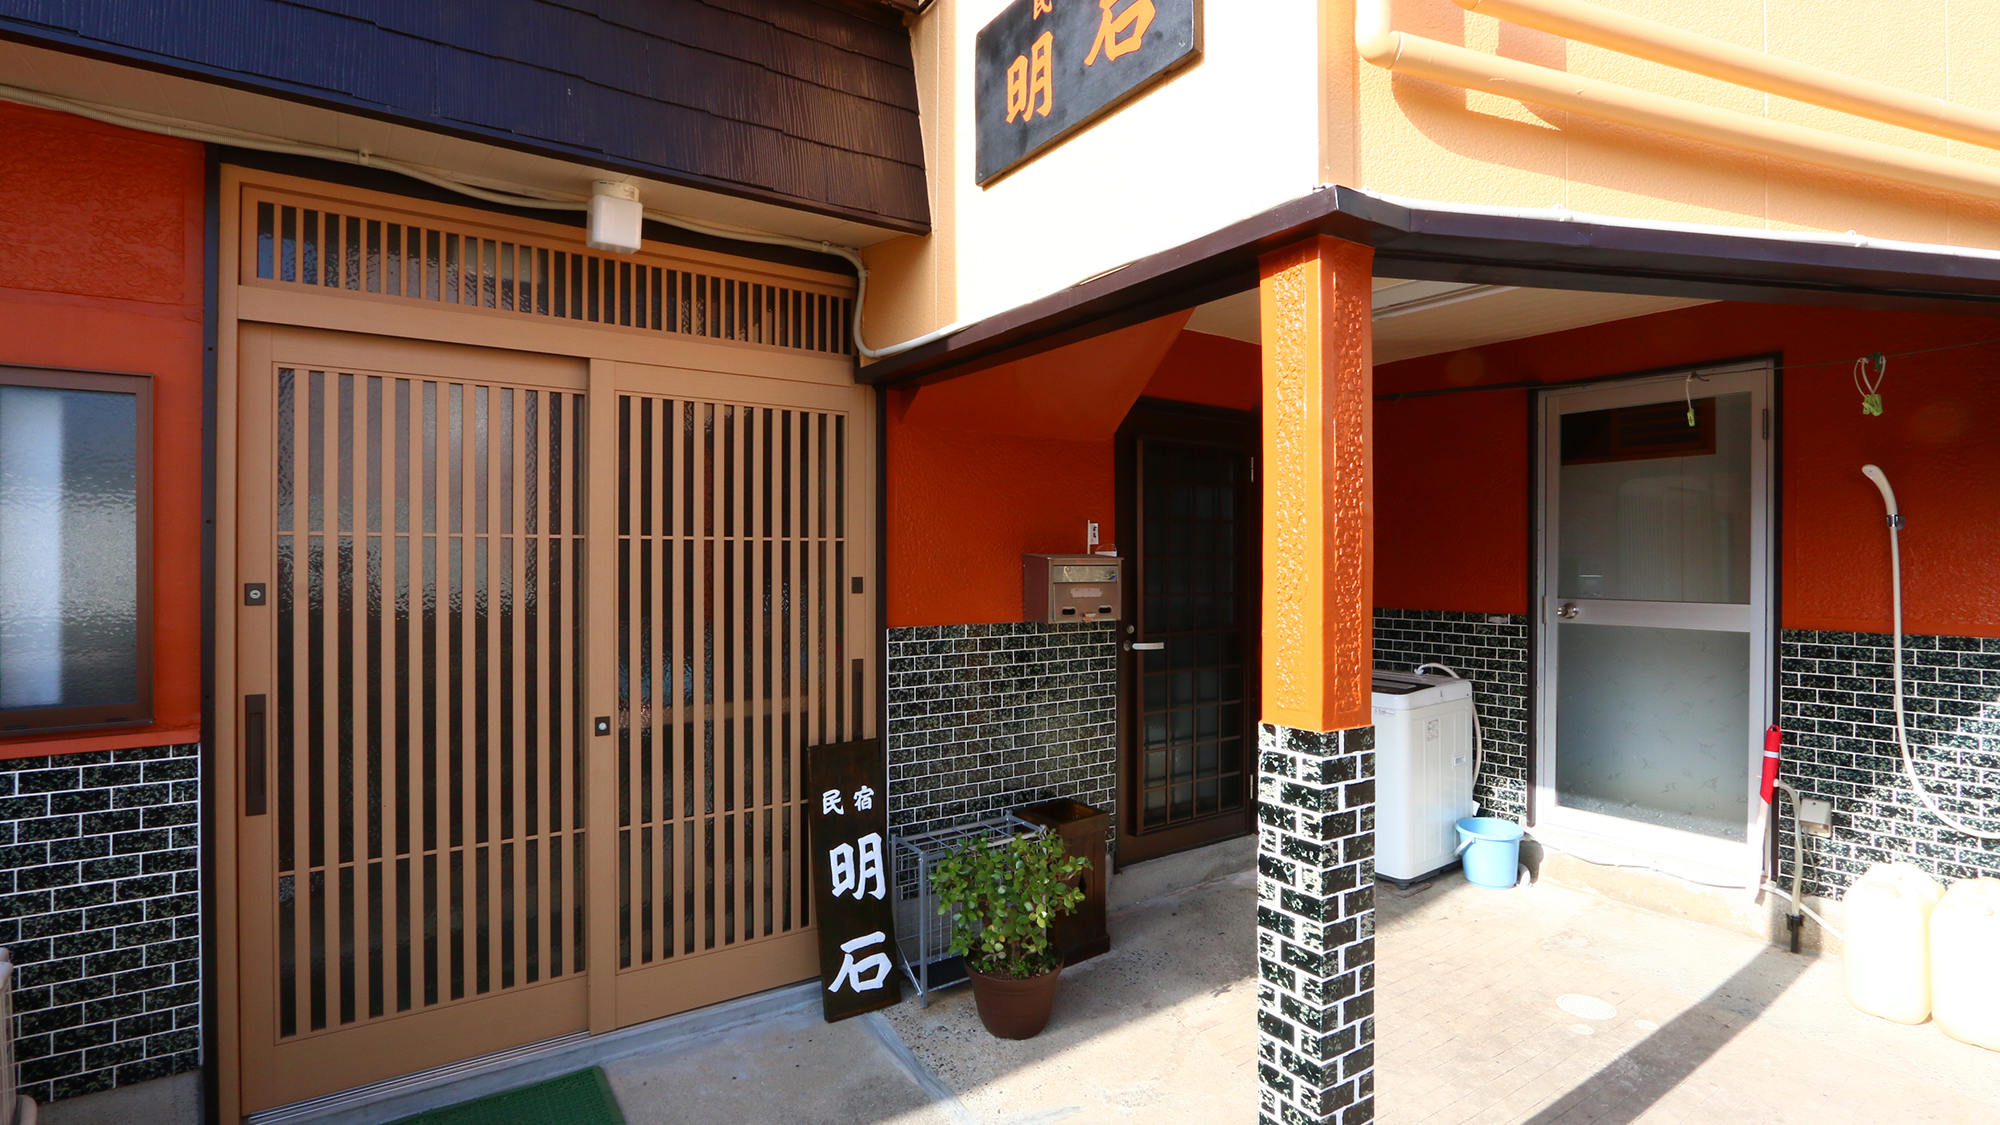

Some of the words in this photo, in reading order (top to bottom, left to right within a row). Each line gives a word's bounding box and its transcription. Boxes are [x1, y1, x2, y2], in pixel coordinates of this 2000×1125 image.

[1006, 0, 1156, 123] 明石
[822, 785, 875, 815] 民宿
[828, 832, 892, 993] 明石
